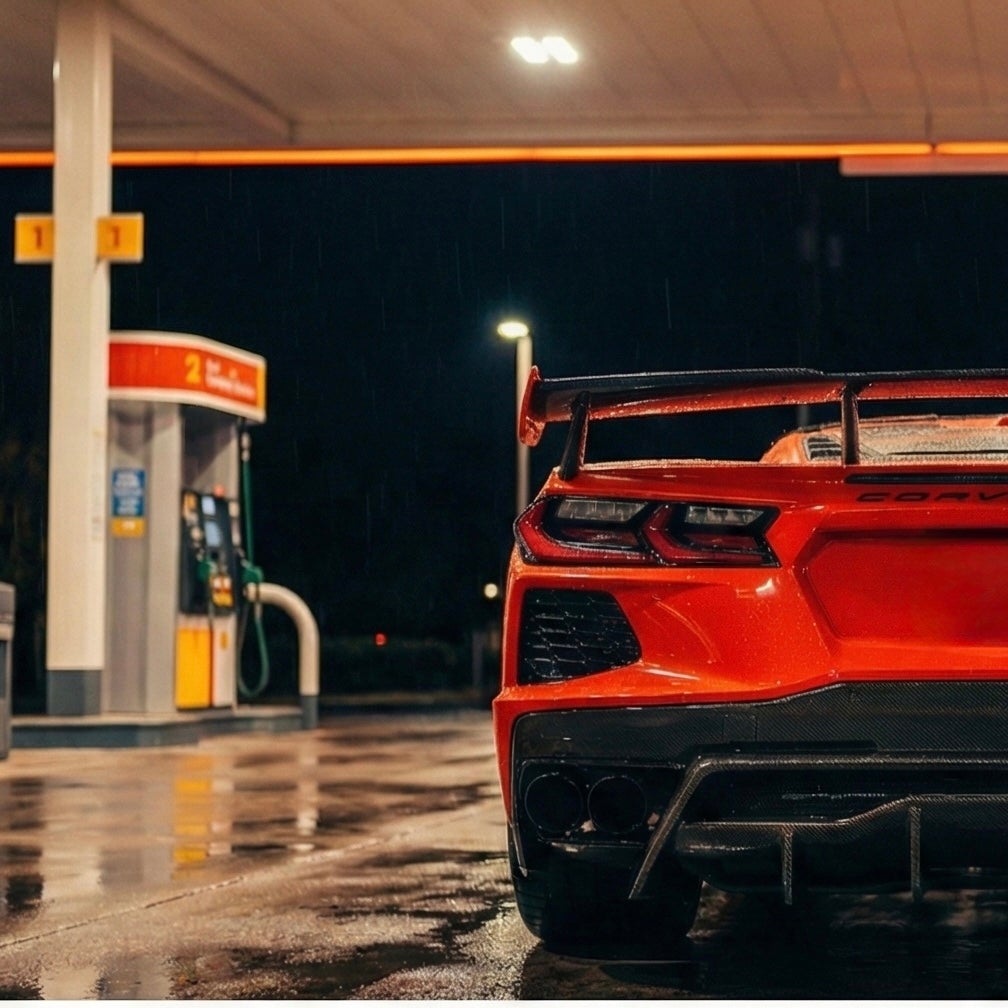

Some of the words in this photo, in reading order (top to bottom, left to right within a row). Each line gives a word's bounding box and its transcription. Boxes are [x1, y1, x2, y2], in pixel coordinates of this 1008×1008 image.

[33, 224, 43, 252] 1
[111, 224, 121, 250] 1
[184, 352, 201, 385] 2
